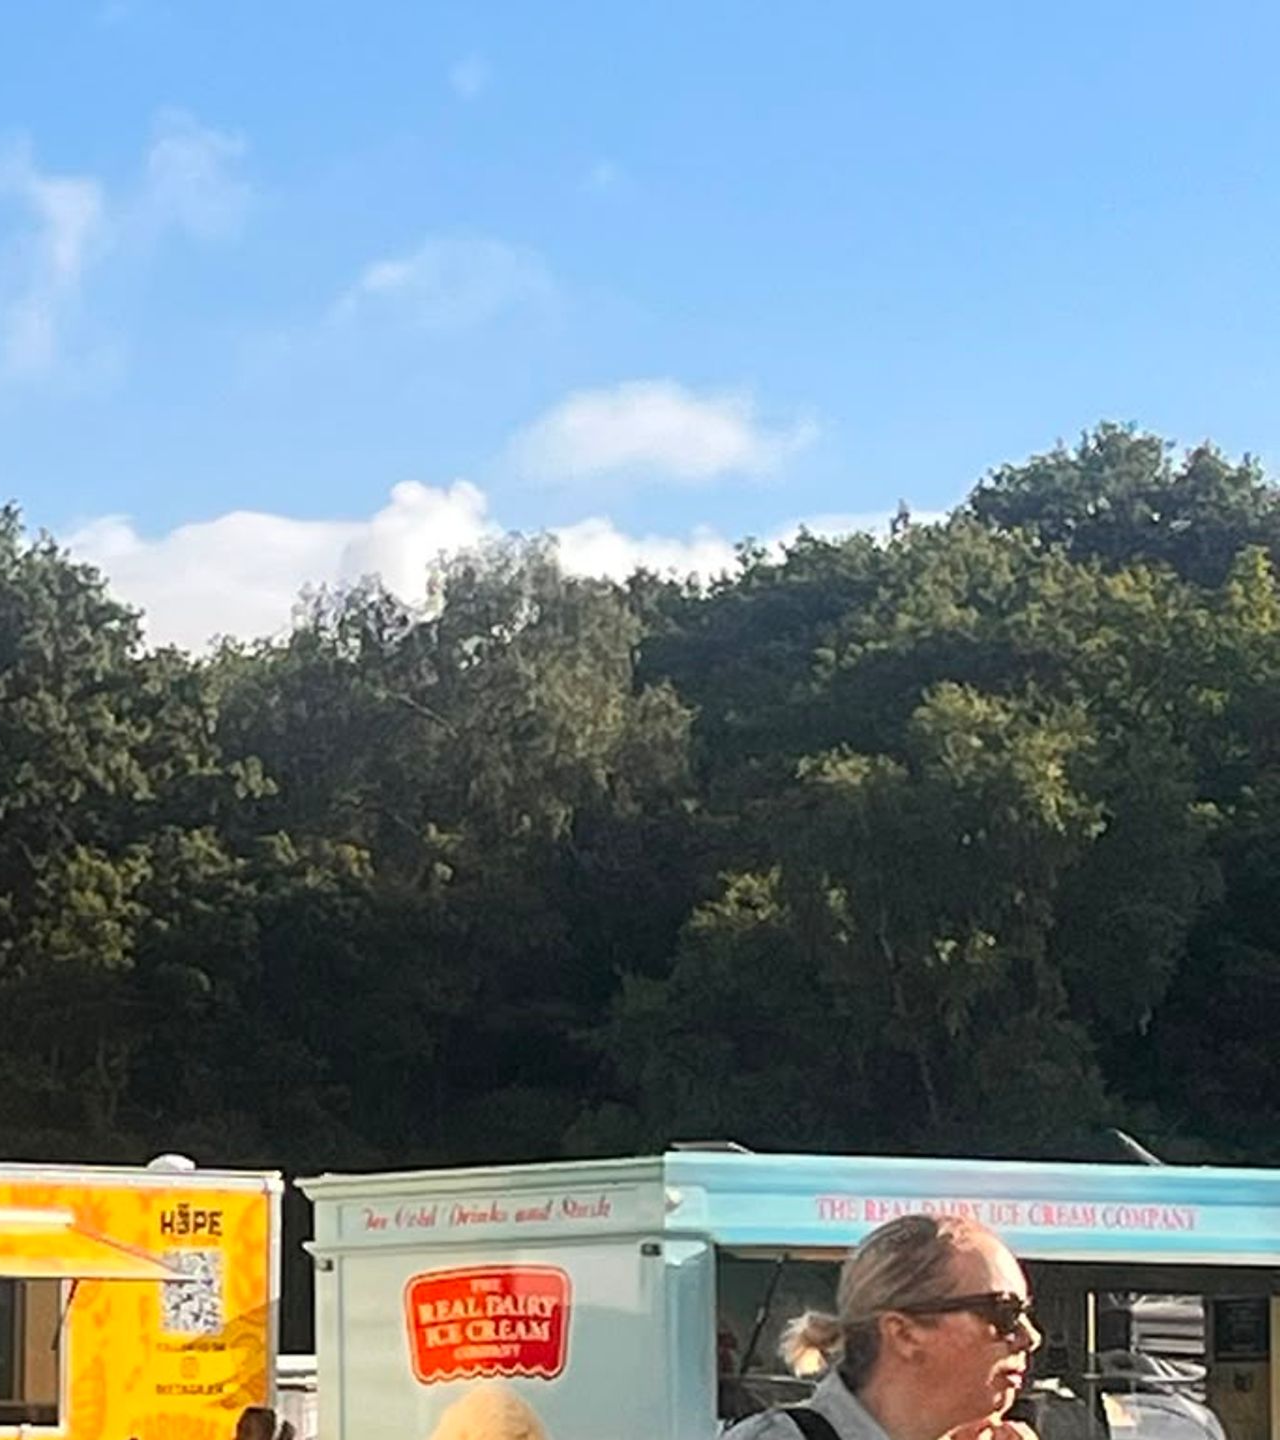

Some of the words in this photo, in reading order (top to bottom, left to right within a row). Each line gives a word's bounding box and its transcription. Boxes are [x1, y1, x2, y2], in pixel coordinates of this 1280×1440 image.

[160, 1210, 223, 1236] HOPE
[450, 1200, 508, 1227] Drinks
[515, 1199, 553, 1224] and
[816, 1198, 859, 1222] THE
[990, 1202, 1024, 1226] ICE
[1028, 1203, 1096, 1228] CREAM
[1101, 1205, 1199, 1232] COMPANY
[418, 1297, 484, 1325] REAL
[485, 1295, 558, 1318] DAIRY
[425, 1323, 462, 1348] ICE
[465, 1320, 550, 1342] CREAM
